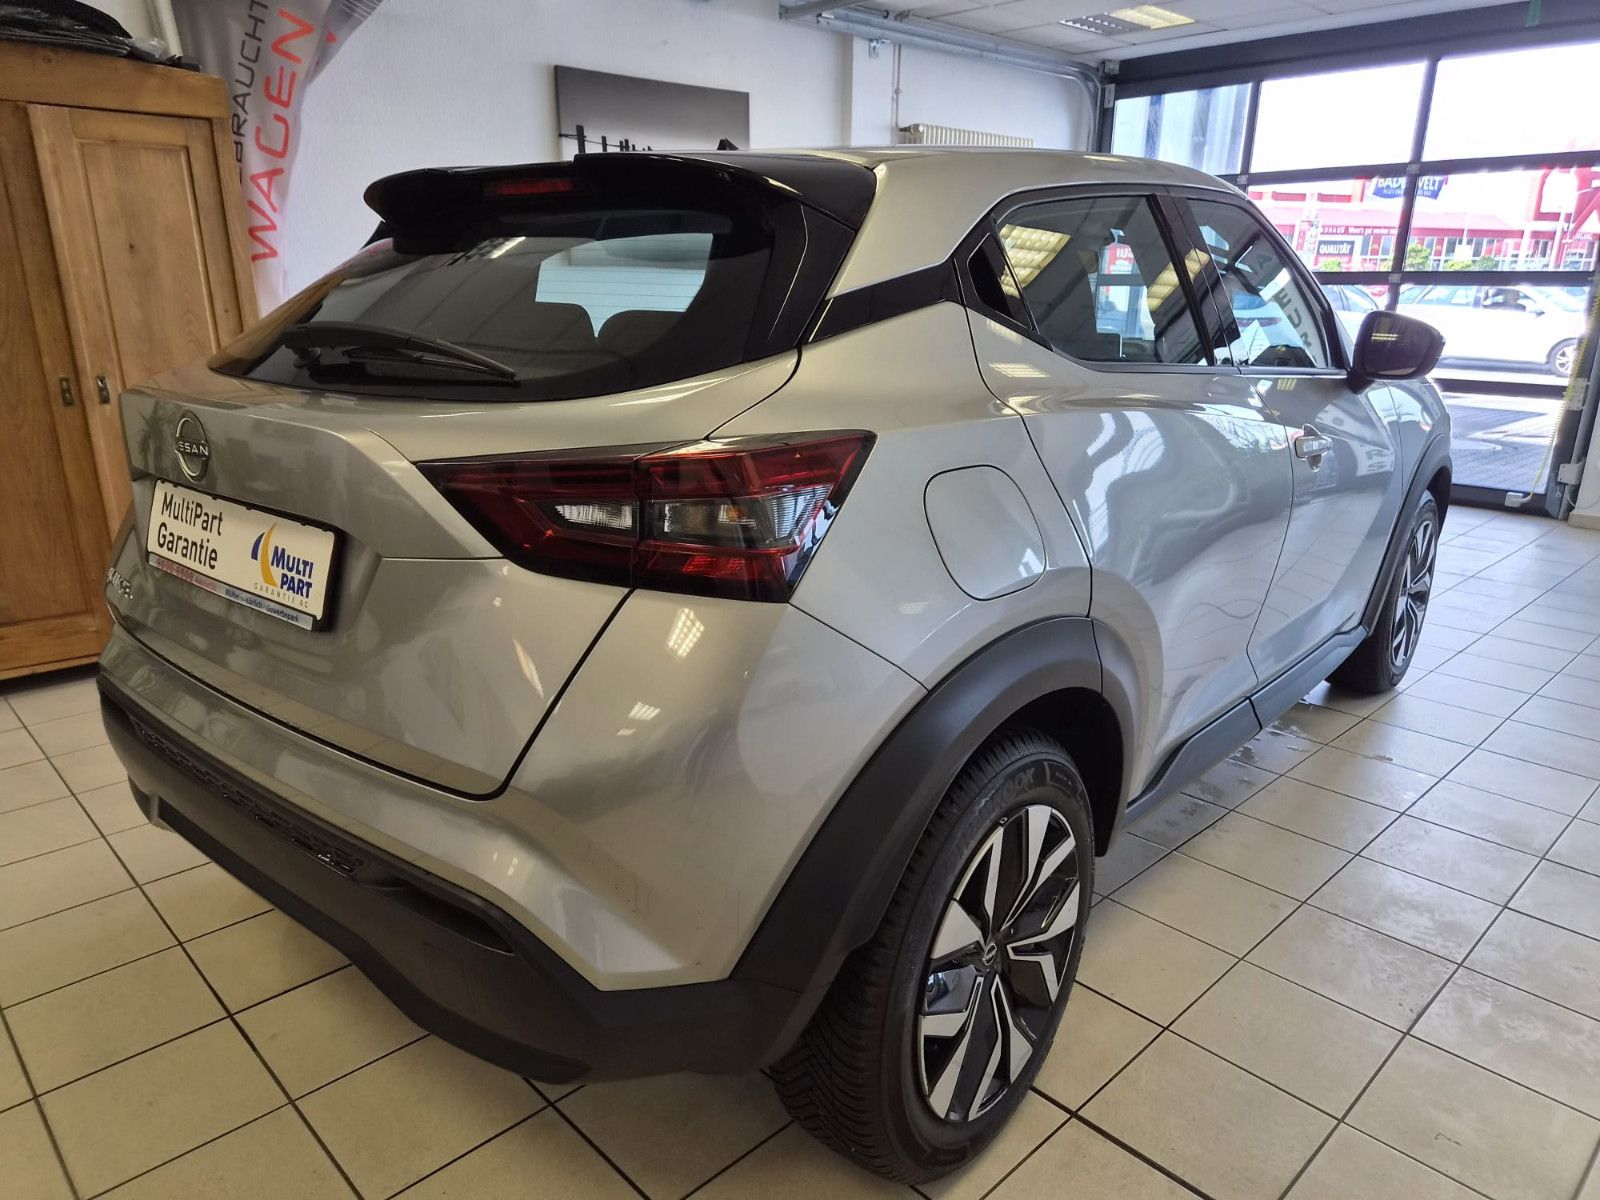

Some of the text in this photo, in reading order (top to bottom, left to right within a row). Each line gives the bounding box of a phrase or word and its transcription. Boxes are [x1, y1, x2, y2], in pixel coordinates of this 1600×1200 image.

[231, 0, 268, 184] BRAUCHT
[247, 8, 315, 262] WAGEN
[1319, 242, 1352, 255] QUALITÄT
[161, 492, 223, 536] MultiPart
[157, 521, 218, 570] Garantie
[270, 545, 314, 579] MULTI
[253, 582, 295, 604] GARANTIE
[280, 572, 313, 599] PART
